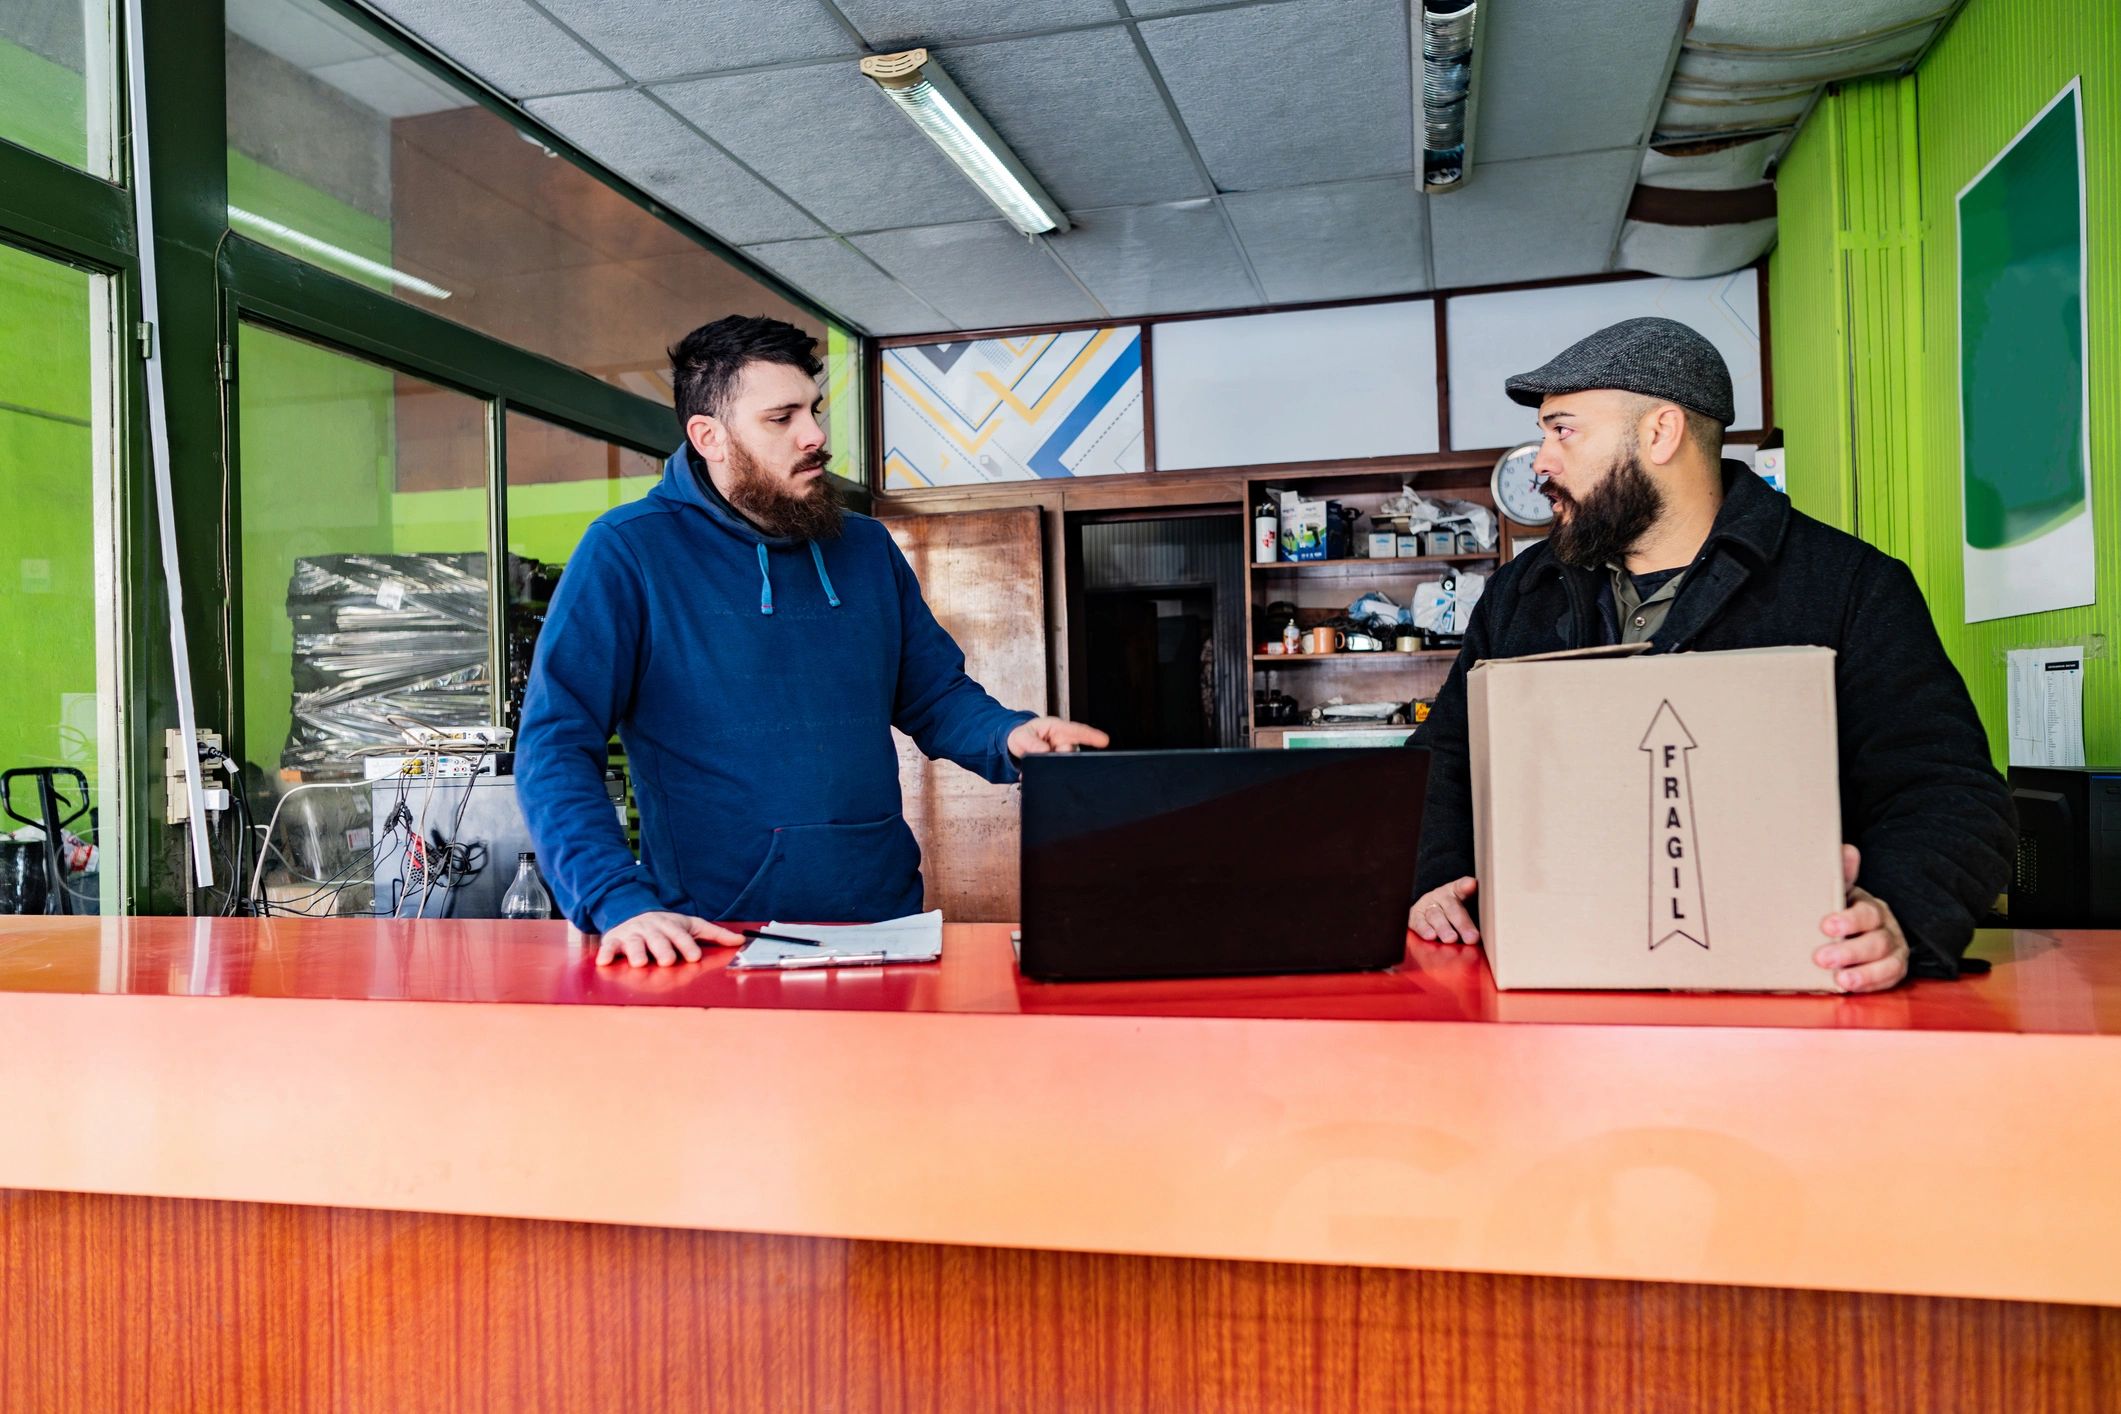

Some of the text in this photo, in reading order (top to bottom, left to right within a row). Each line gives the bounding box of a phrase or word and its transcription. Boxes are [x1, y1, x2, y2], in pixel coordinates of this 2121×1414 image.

[1506, 466, 1515, 475] 10
[1504, 480, 1510, 489] 9
[1519, 503, 1525, 512] 7
[1663, 745, 1685, 919] FRAGIL
